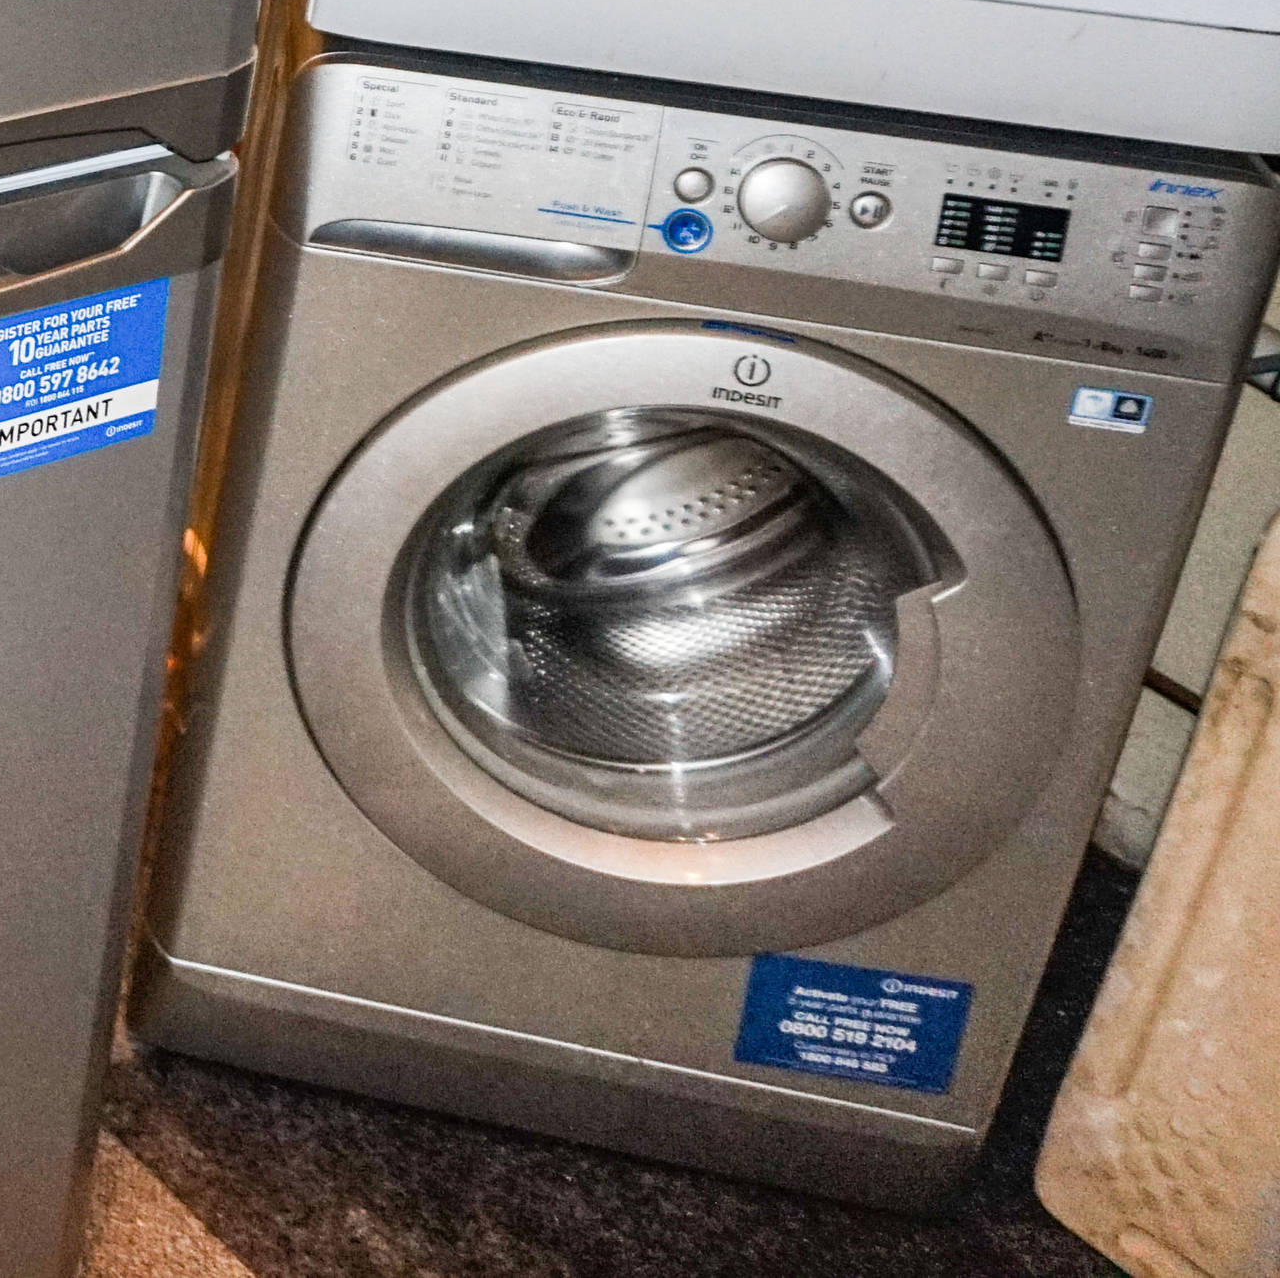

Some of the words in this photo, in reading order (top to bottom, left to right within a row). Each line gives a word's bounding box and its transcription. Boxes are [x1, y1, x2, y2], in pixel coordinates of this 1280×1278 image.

[363, 80, 400, 93] Special
[449, 92, 498, 106] Standard
[556, 106, 576, 118] Eco
[590, 110, 621, 122] Rapid
[806, 149, 816, 159] 2
[862, 166, 894, 176] START
[860, 176, 891, 187] PAUSE
[1148, 178, 1225, 199] Innex
[43, 312, 68, 330] FOR
[71, 304, 103, 323] YOUR
[9, 336, 36, 366] 10
[36, 327, 69, 346] YEAR
[71, 315, 110, 337] PARTS
[35, 329, 110, 359] GUARANTEE
[20, 366, 43, 379] CALL
[44, 359, 68, 373] FREE
[39, 368, 74, 394] 597
[76, 356, 120, 383] 8642
[880, 997, 919, 1013] FREE
[793, 1010, 831, 1025] CALL
[834, 1016, 872, 1032] FREE
[874, 1023, 911, 1037] NOW
[779, 1019, 828, 1039] 0800
[831, 1027, 868, 1045] 519
[870, 1033, 917, 1054] 2104
